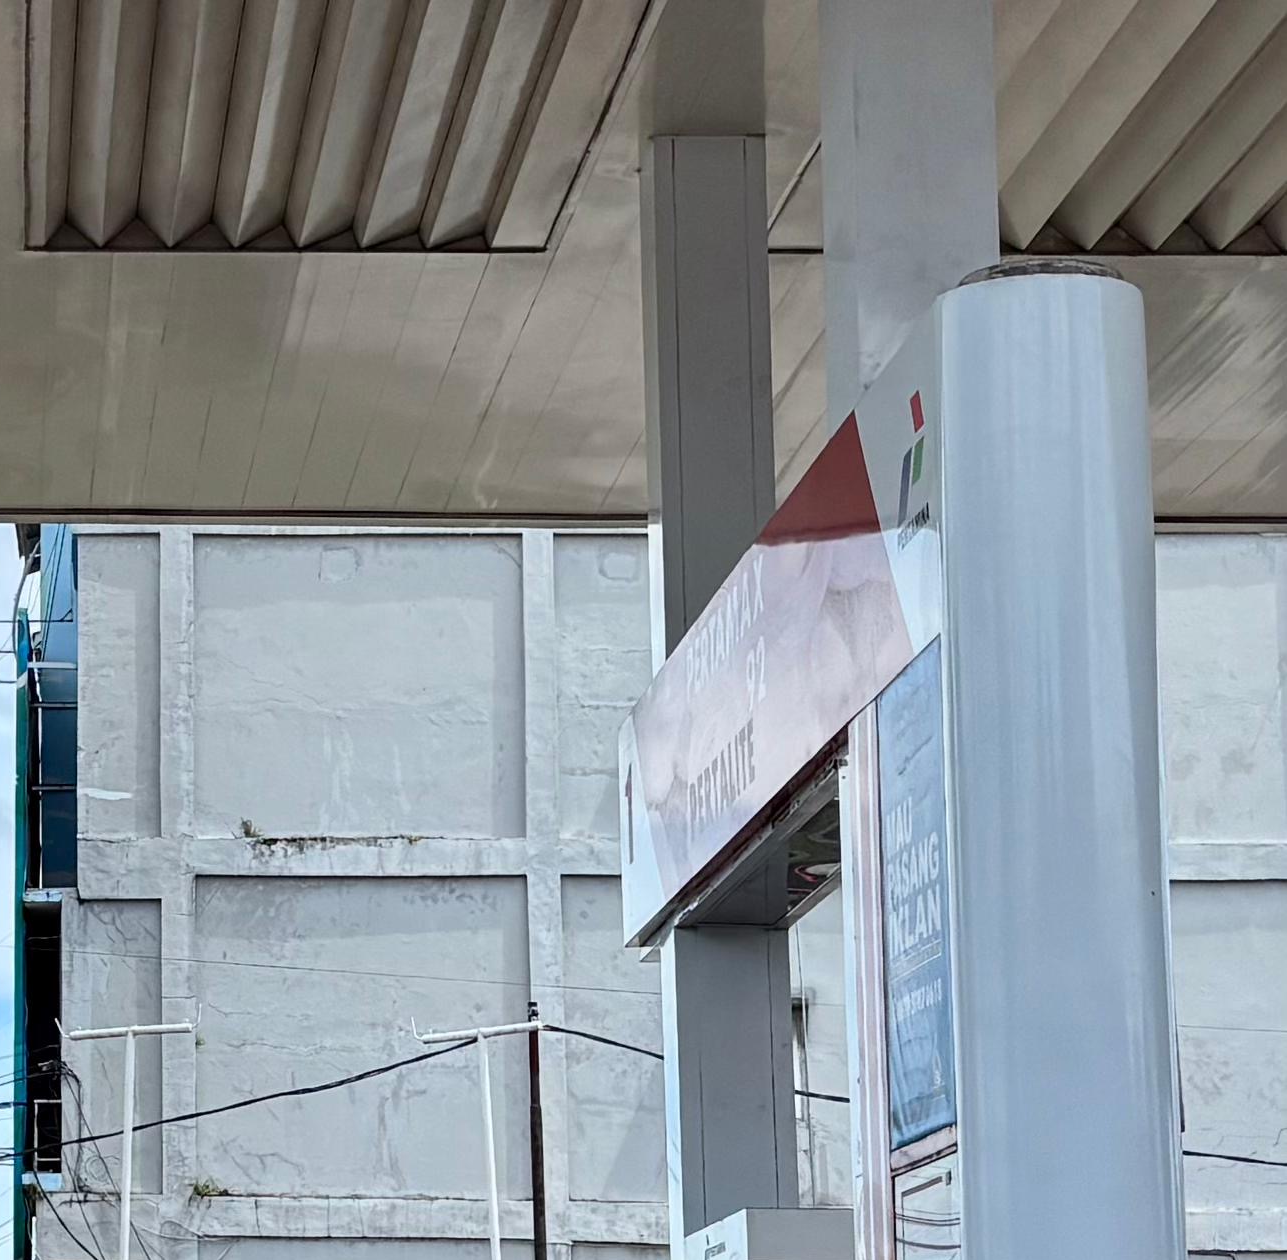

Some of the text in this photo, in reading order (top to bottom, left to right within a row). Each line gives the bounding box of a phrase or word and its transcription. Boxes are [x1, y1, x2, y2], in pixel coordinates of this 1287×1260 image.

[686, 552, 764, 699] PERTAMAX
[746, 634, 767, 715] 92
[688, 717, 756, 842] PERTALITE
[887, 831, 940, 910] PASANG
[888, 883, 942, 960] IKLAN
